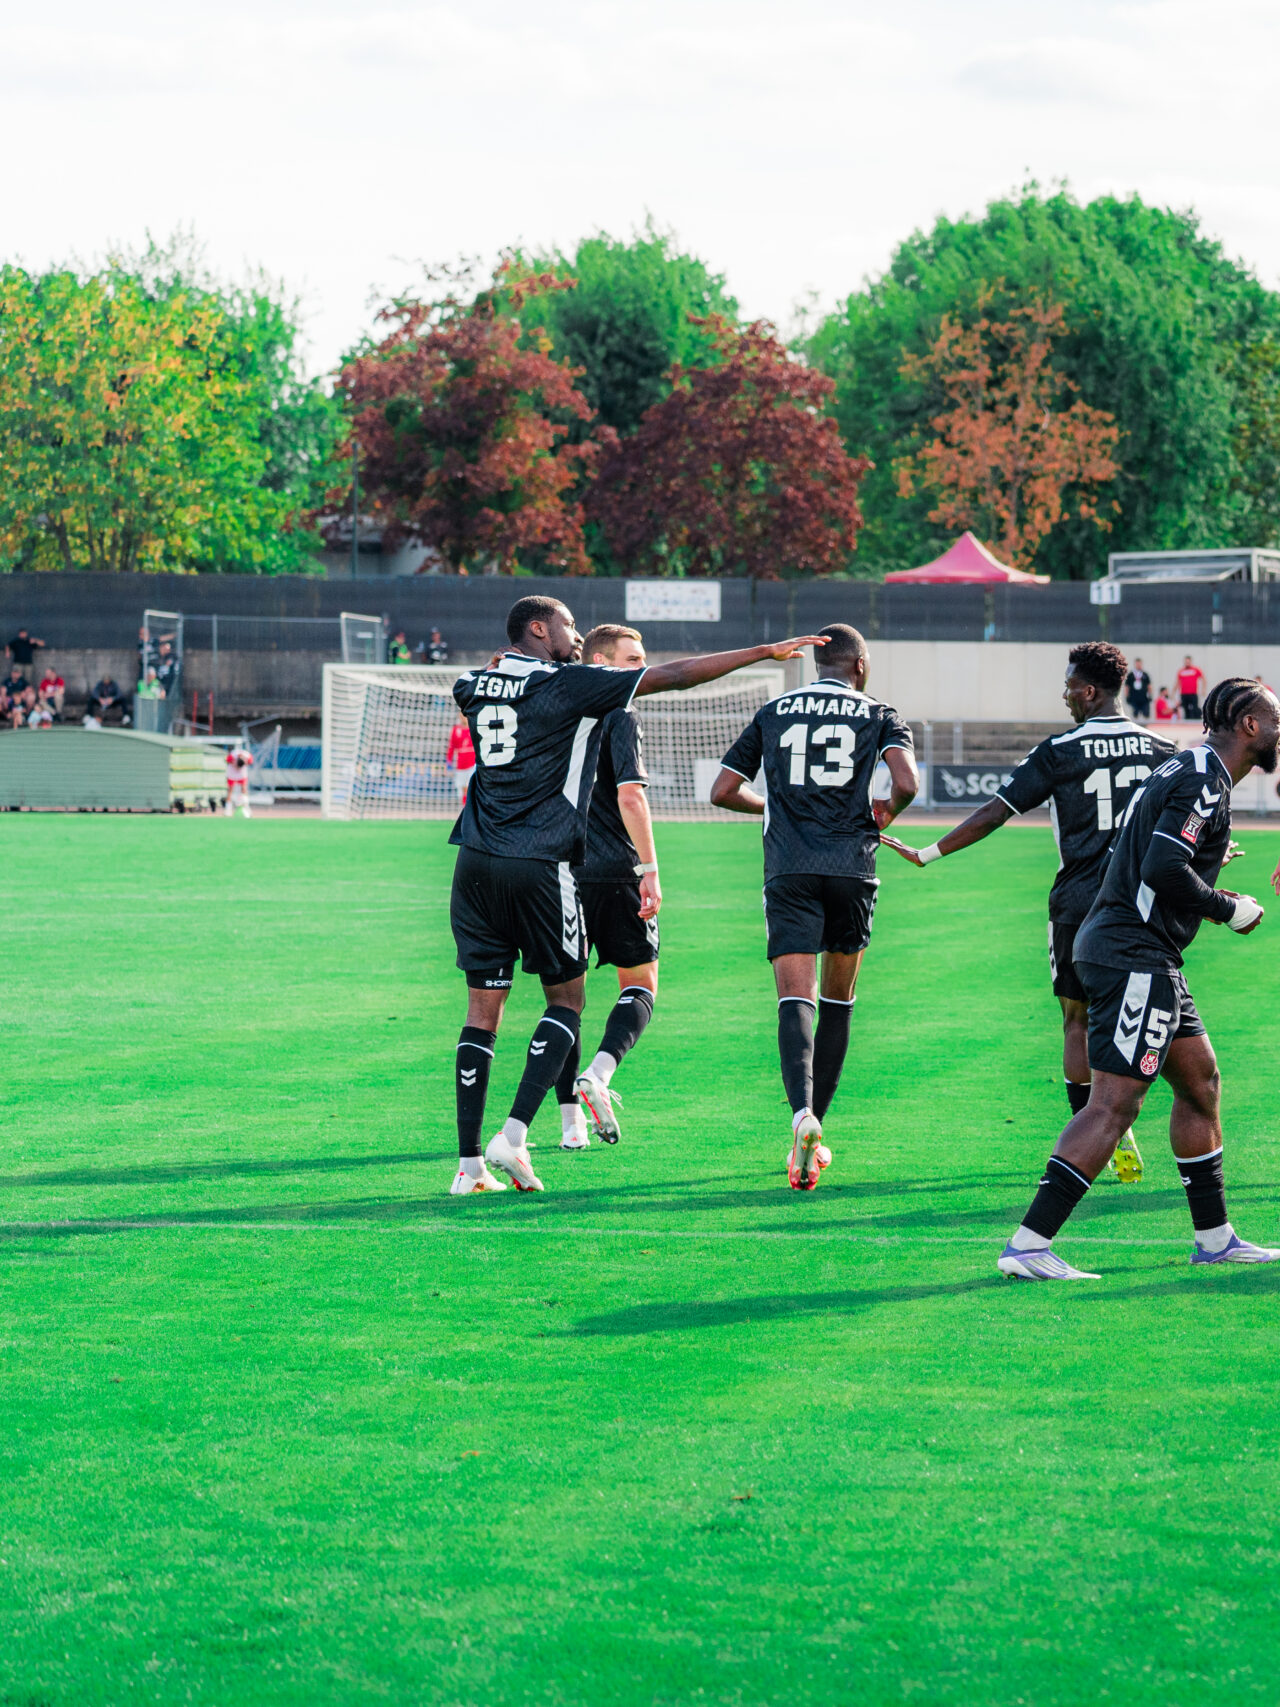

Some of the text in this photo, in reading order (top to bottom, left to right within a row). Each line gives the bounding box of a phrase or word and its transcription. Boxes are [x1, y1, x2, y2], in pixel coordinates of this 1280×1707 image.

[776, 697, 870, 718] CAMARA
[477, 705, 518, 767] 8
[779, 723, 856, 786] 13
[1080, 736, 1153, 759] TOURE
[1083, 765, 1152, 831] 12
[1145, 1007, 1172, 1048] 5
